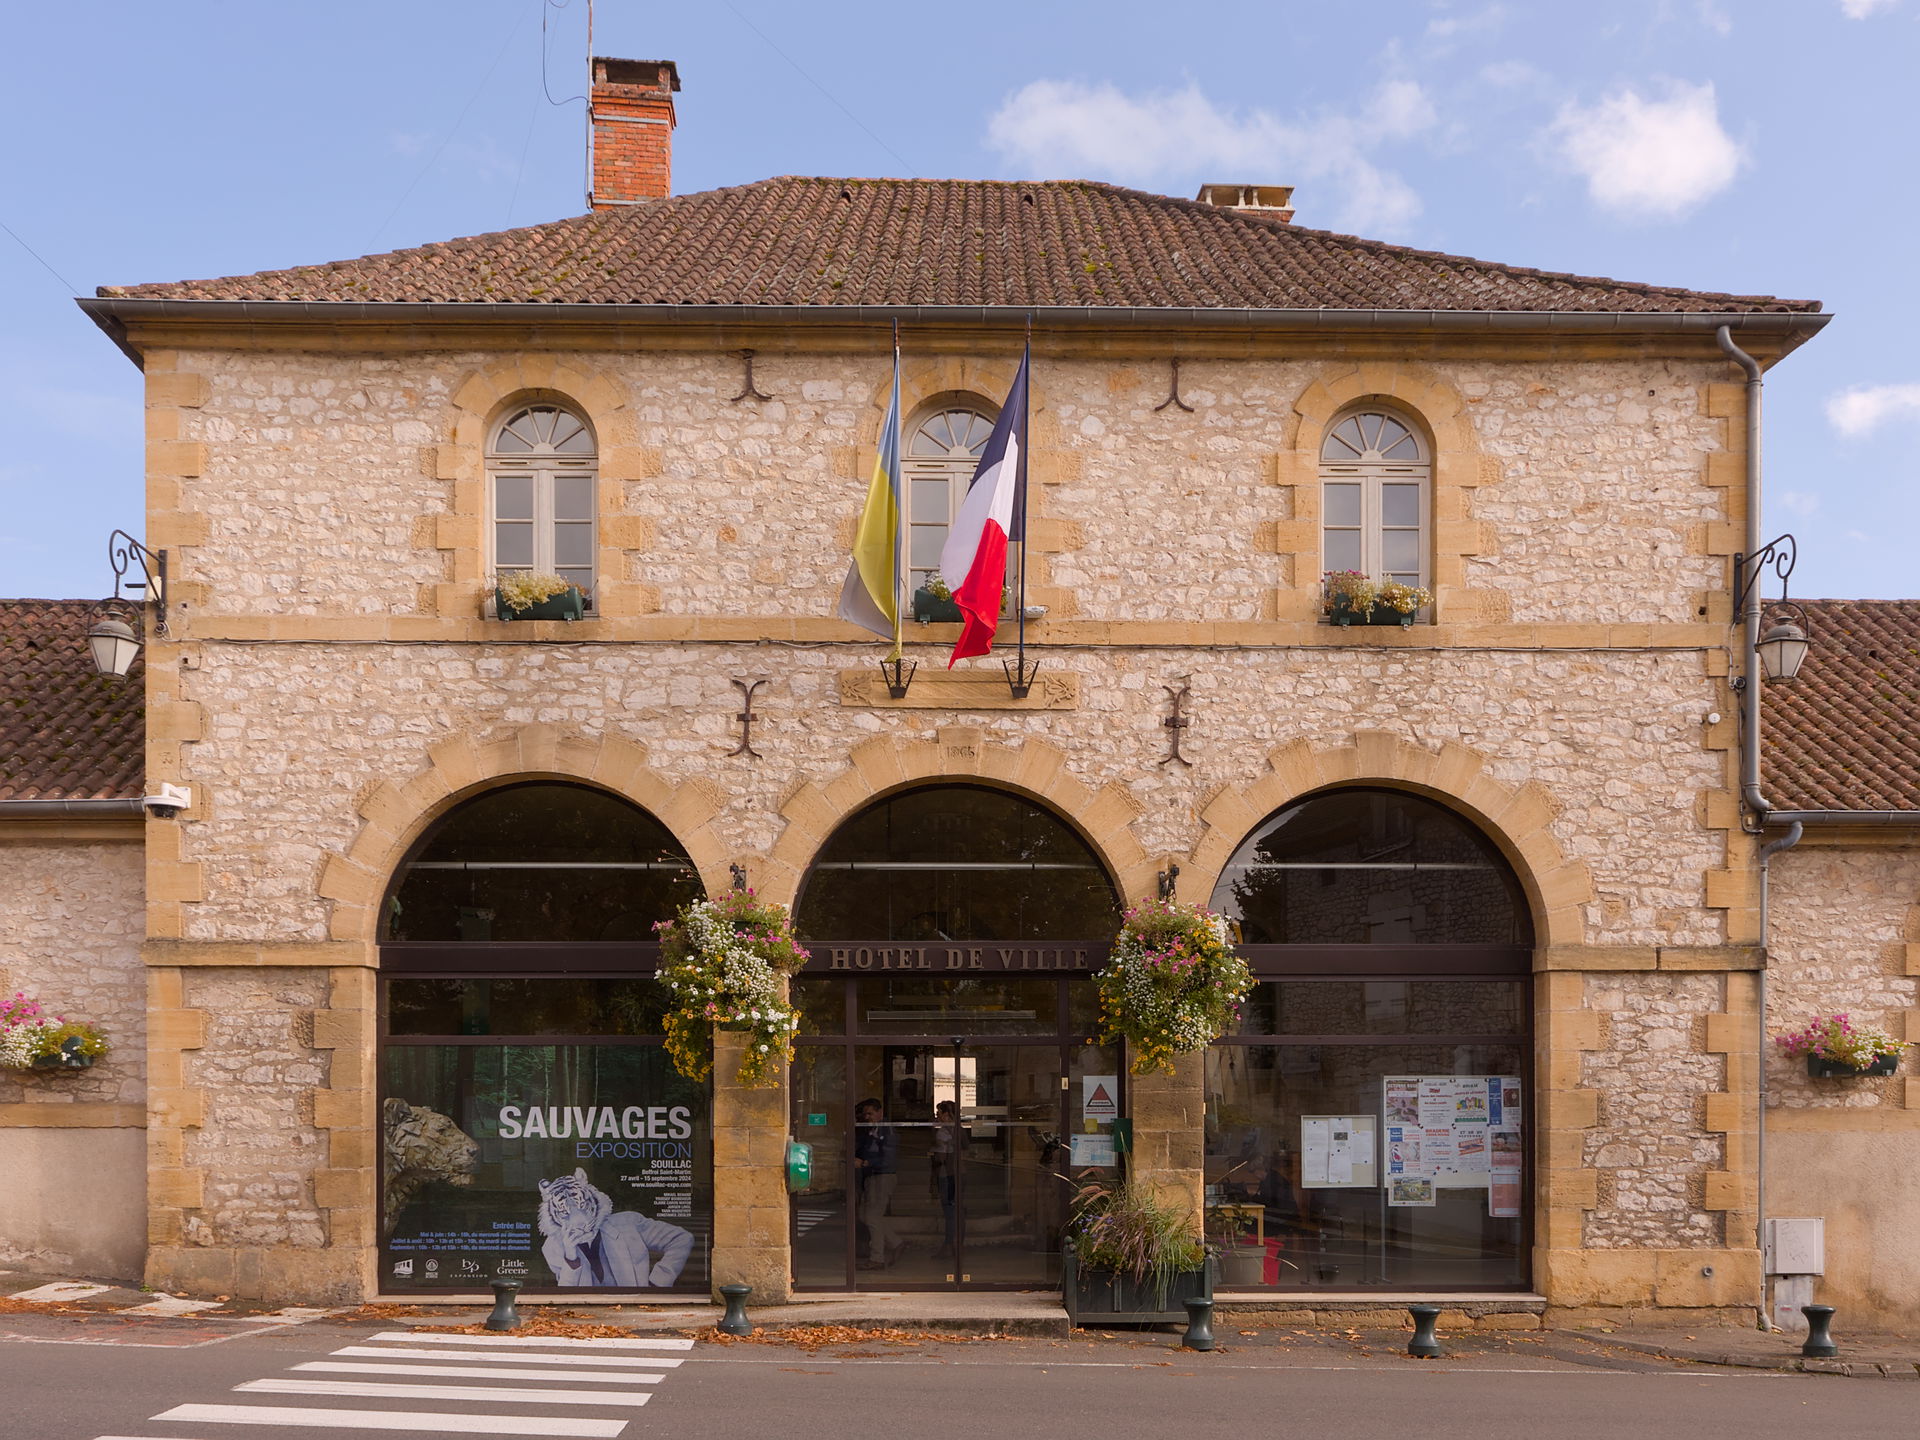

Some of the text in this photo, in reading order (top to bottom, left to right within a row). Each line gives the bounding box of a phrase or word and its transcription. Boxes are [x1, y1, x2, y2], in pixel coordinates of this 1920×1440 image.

[945, 948, 984, 969] DE
[997, 948, 1088, 969] VILLE
[499, 1105, 692, 1140] SAUVAGES
[576, 1142, 692, 1159] EXPOSITION
[651, 1159, 692, 1169] SOUILLAC
[492, 1221, 531, 1230] Entrée libre
[501, 1259, 525, 1268] Little
[496, 1267, 529, 1275] Greene
